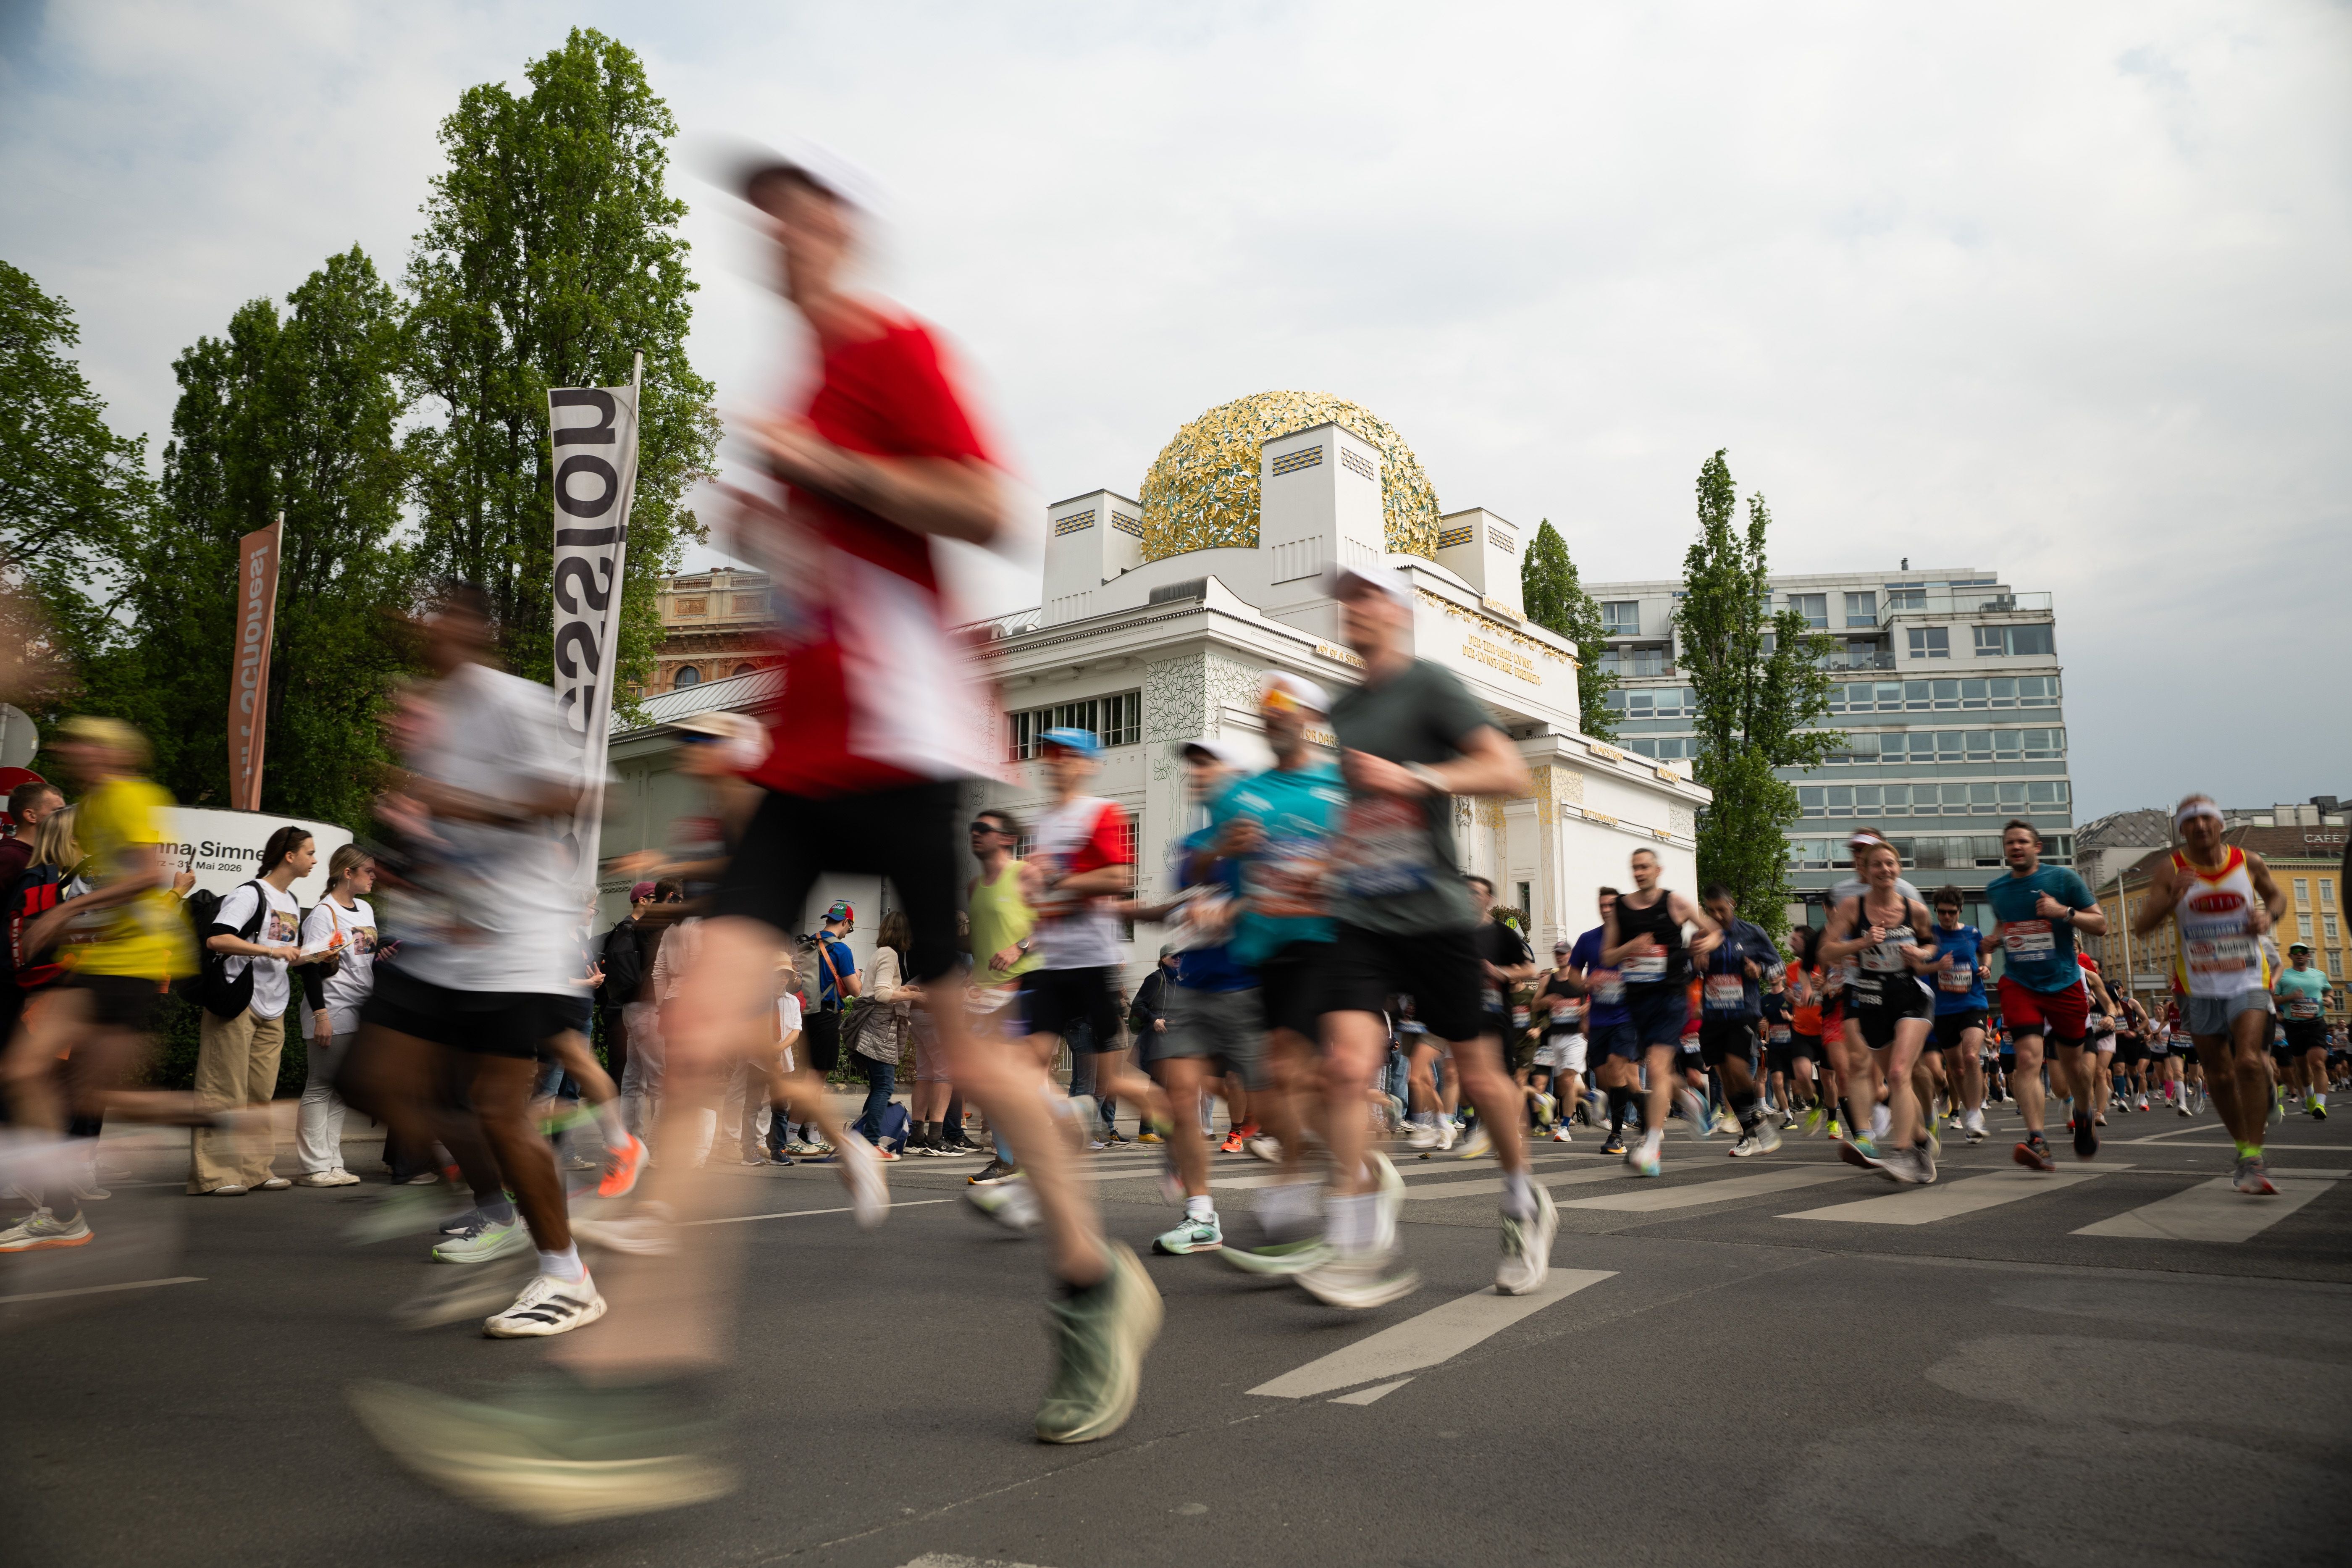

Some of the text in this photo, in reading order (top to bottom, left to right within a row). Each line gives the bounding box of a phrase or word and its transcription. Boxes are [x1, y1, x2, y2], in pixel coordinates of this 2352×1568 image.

[1318, 644, 1328, 655] JOY
[1330, 648, 1337, 658] OF
[1339, 651, 1343, 661] A
[1305, 728, 1317, 741] OR
[1658, 766, 1680, 784] PROMISE
[2304, 832, 2344, 843] CAFÉ
[196, 861, 215, 870] Mai
[218, 863, 242, 872] 2026
